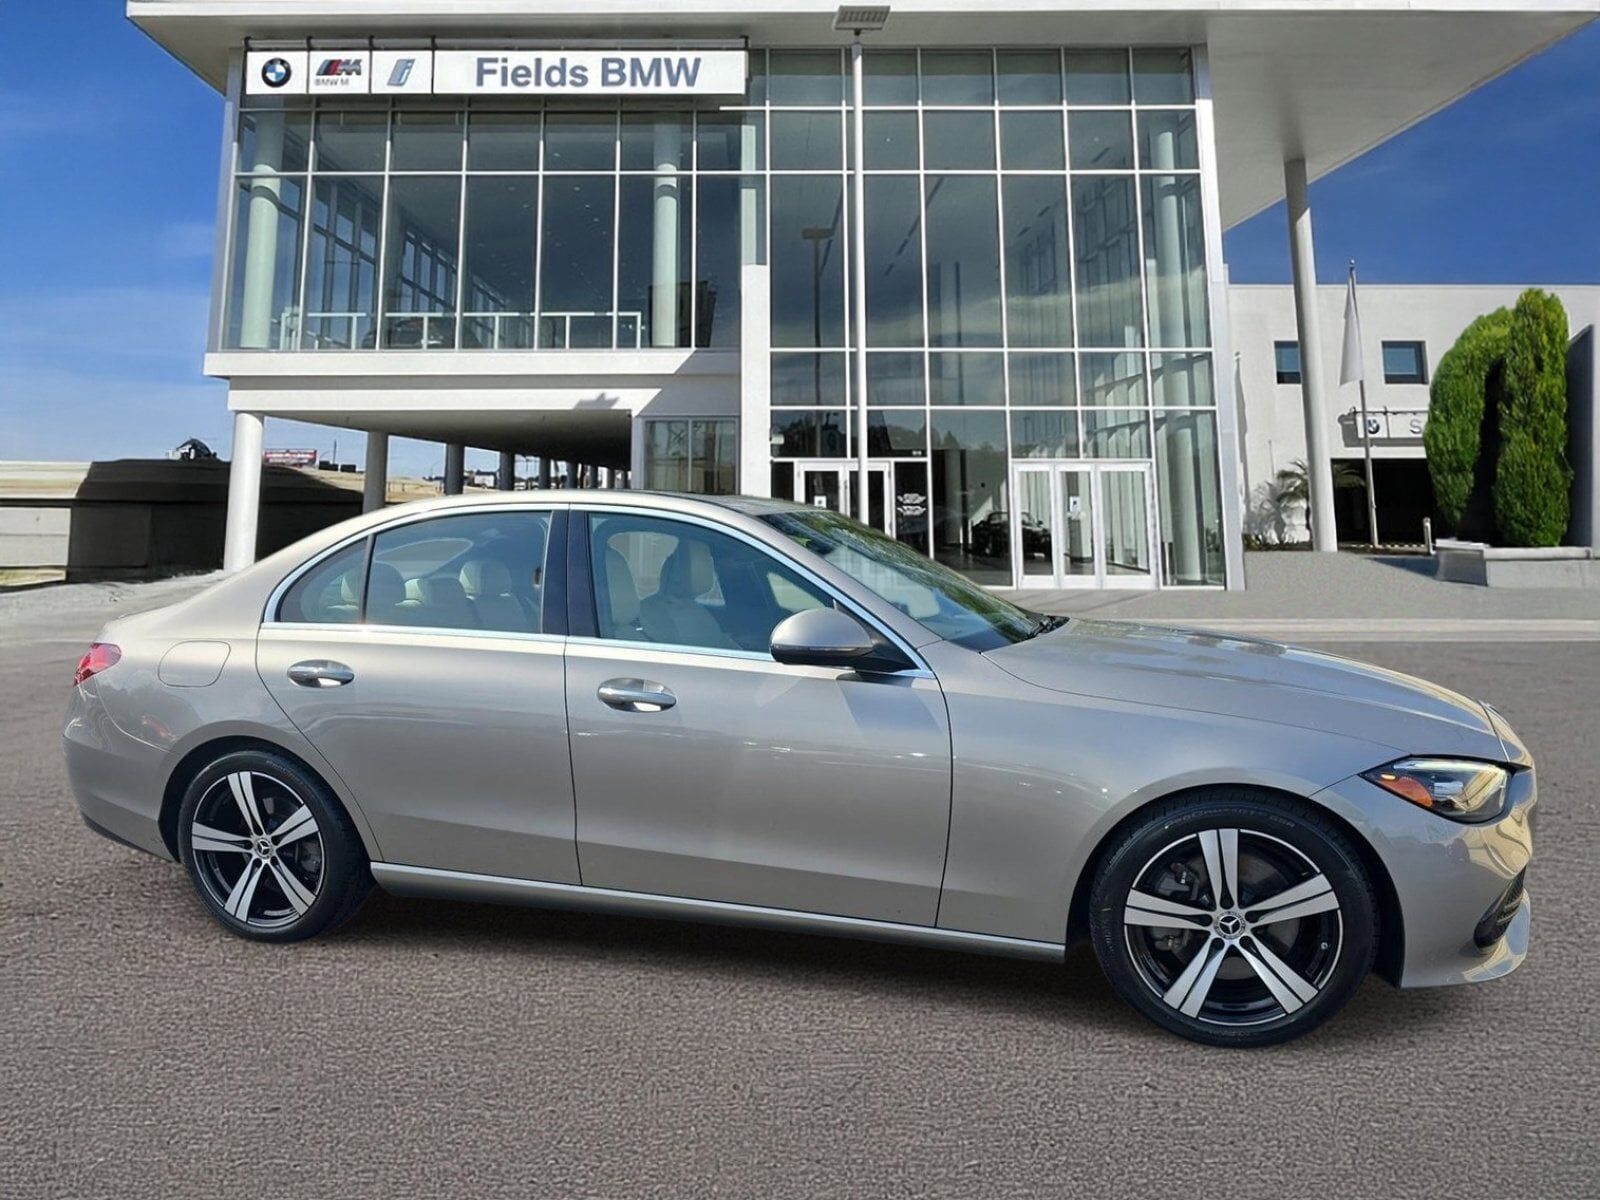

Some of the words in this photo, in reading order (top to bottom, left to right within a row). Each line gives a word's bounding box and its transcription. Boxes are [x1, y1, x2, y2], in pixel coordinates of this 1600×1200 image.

[475, 57, 589, 87] Fields
[601, 57, 702, 87] BMW
[314, 78, 339, 86] BMW
